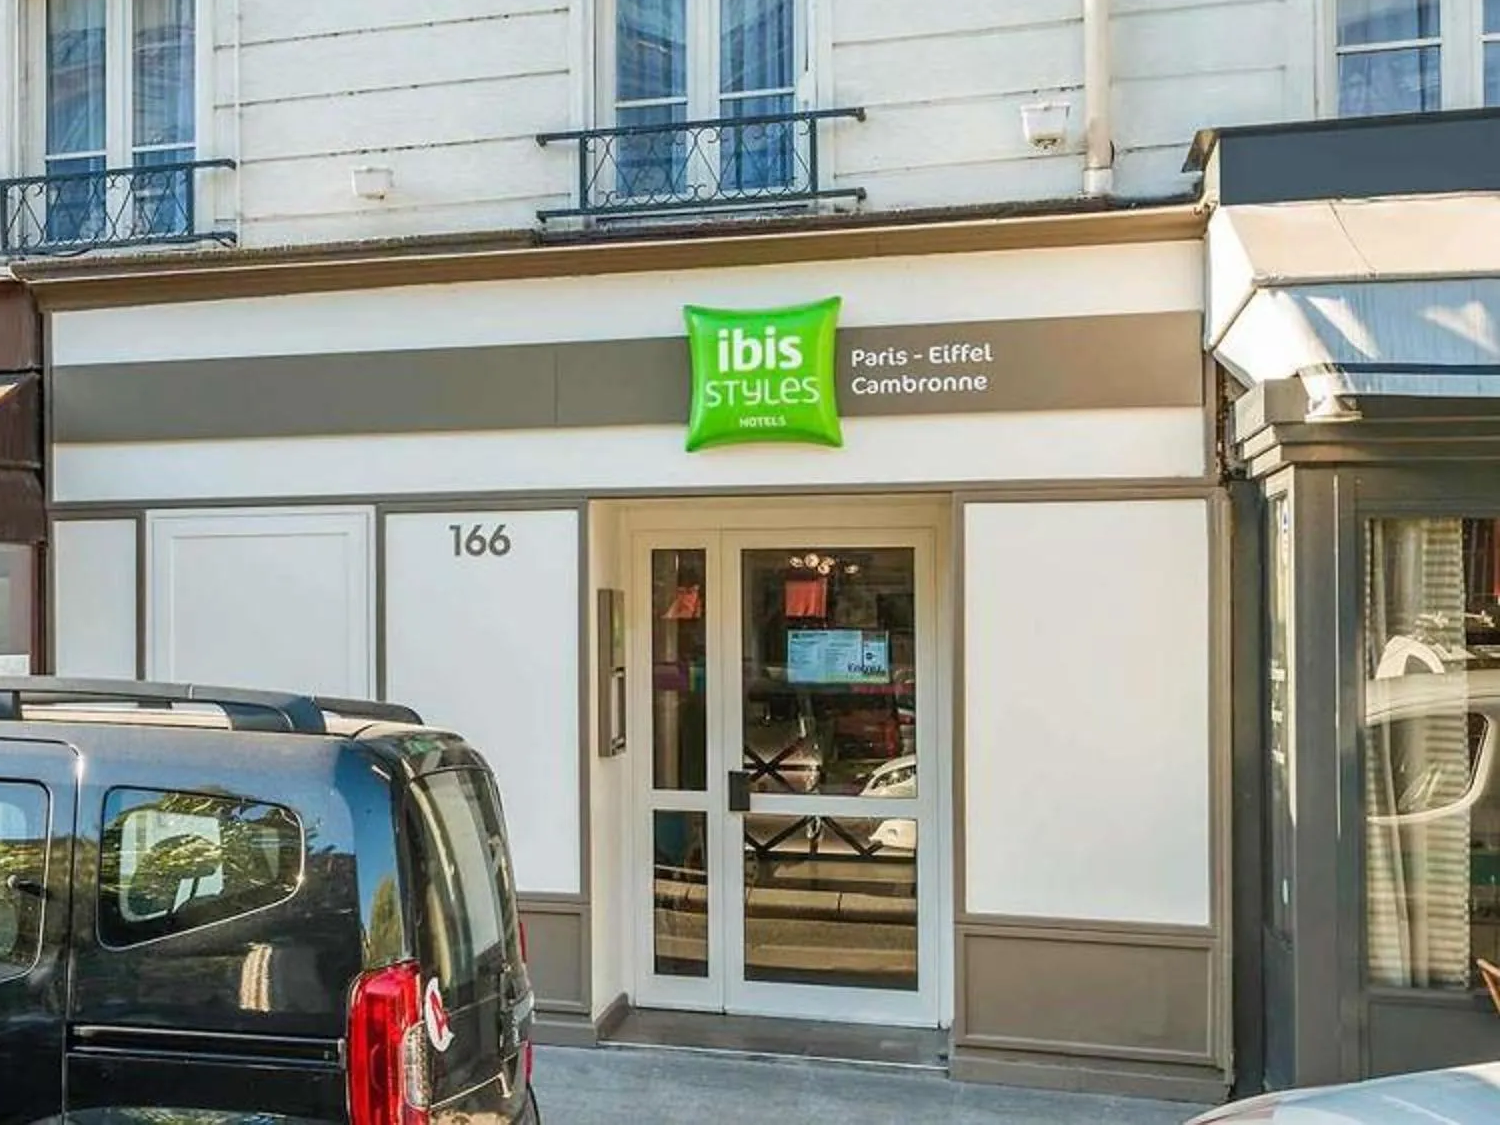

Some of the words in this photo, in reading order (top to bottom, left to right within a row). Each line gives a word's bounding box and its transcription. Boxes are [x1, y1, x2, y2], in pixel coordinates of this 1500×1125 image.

[717, 326, 803, 373] ibis
[851, 347, 908, 367] Paris
[929, 343, 994, 364] Eiffel
[851, 375, 988, 395] Cambronne
[739, 415, 787, 428] HOTELS
[449, 523, 511, 557] 166
